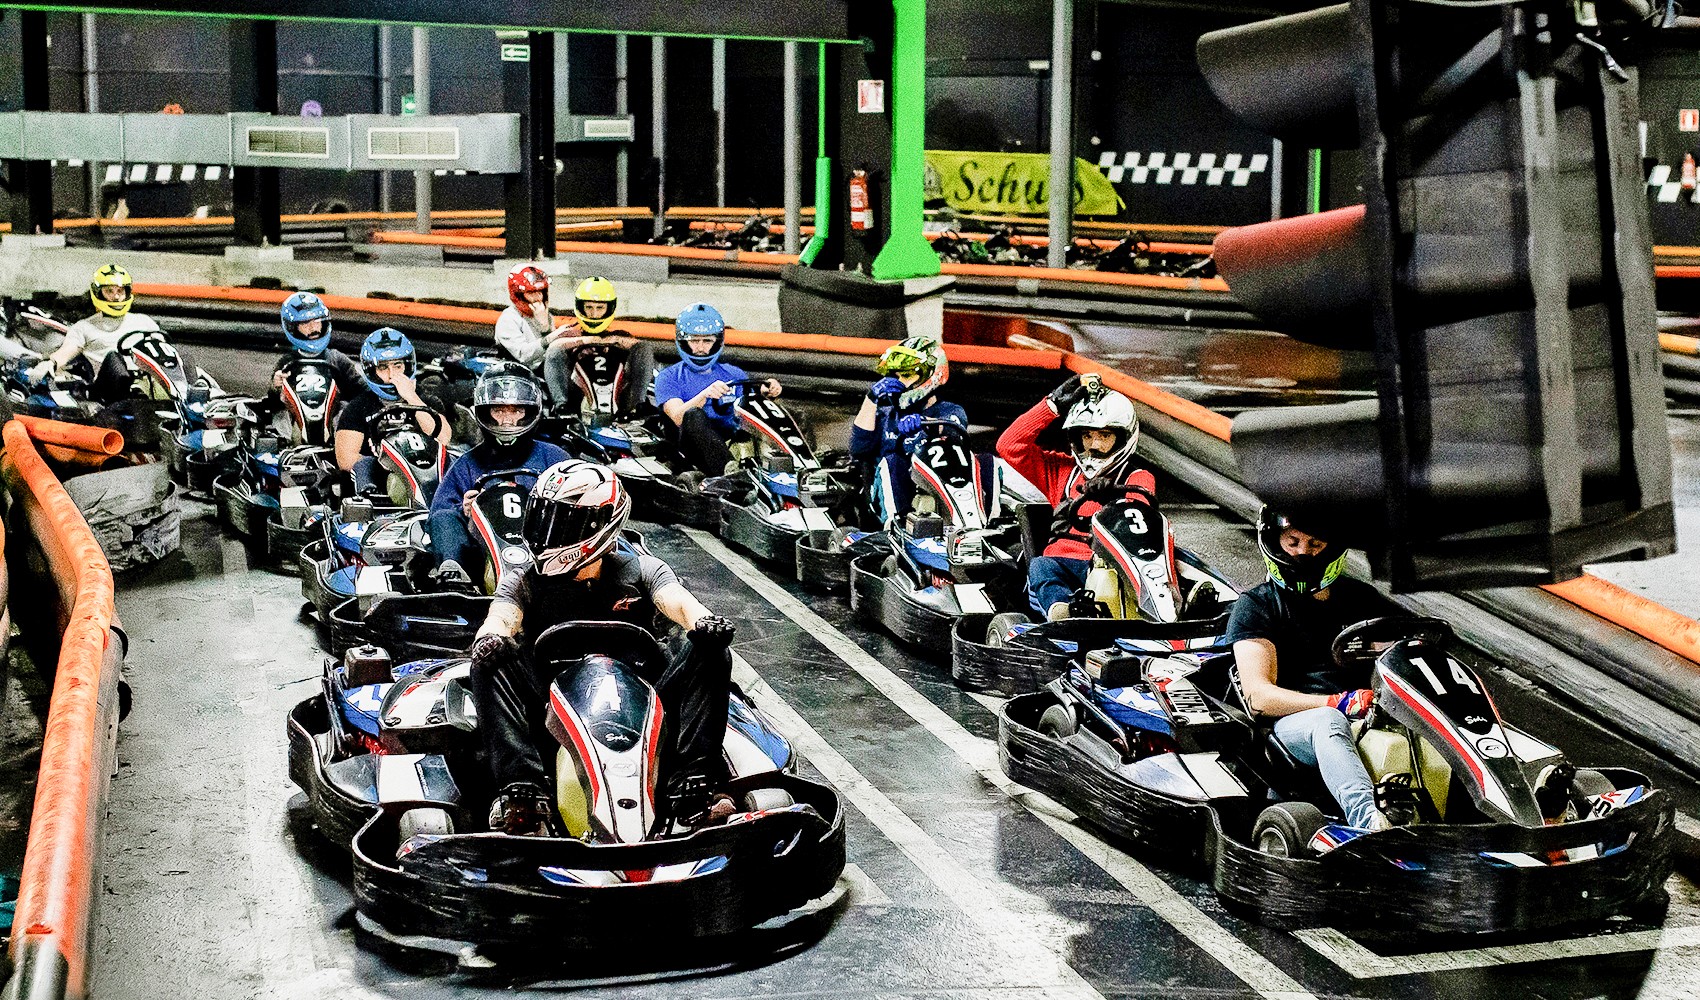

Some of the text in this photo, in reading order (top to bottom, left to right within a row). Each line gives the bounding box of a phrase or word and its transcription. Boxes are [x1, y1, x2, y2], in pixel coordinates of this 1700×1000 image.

[594, 356, 607, 371] 2
[296, 373, 327, 392] 22
[749, 400, 785, 419] 19
[927, 445, 968, 468] 21
[503, 493, 521, 518] 6
[1124, 508, 1148, 534] 3
[1409, 657, 1481, 695] 14
